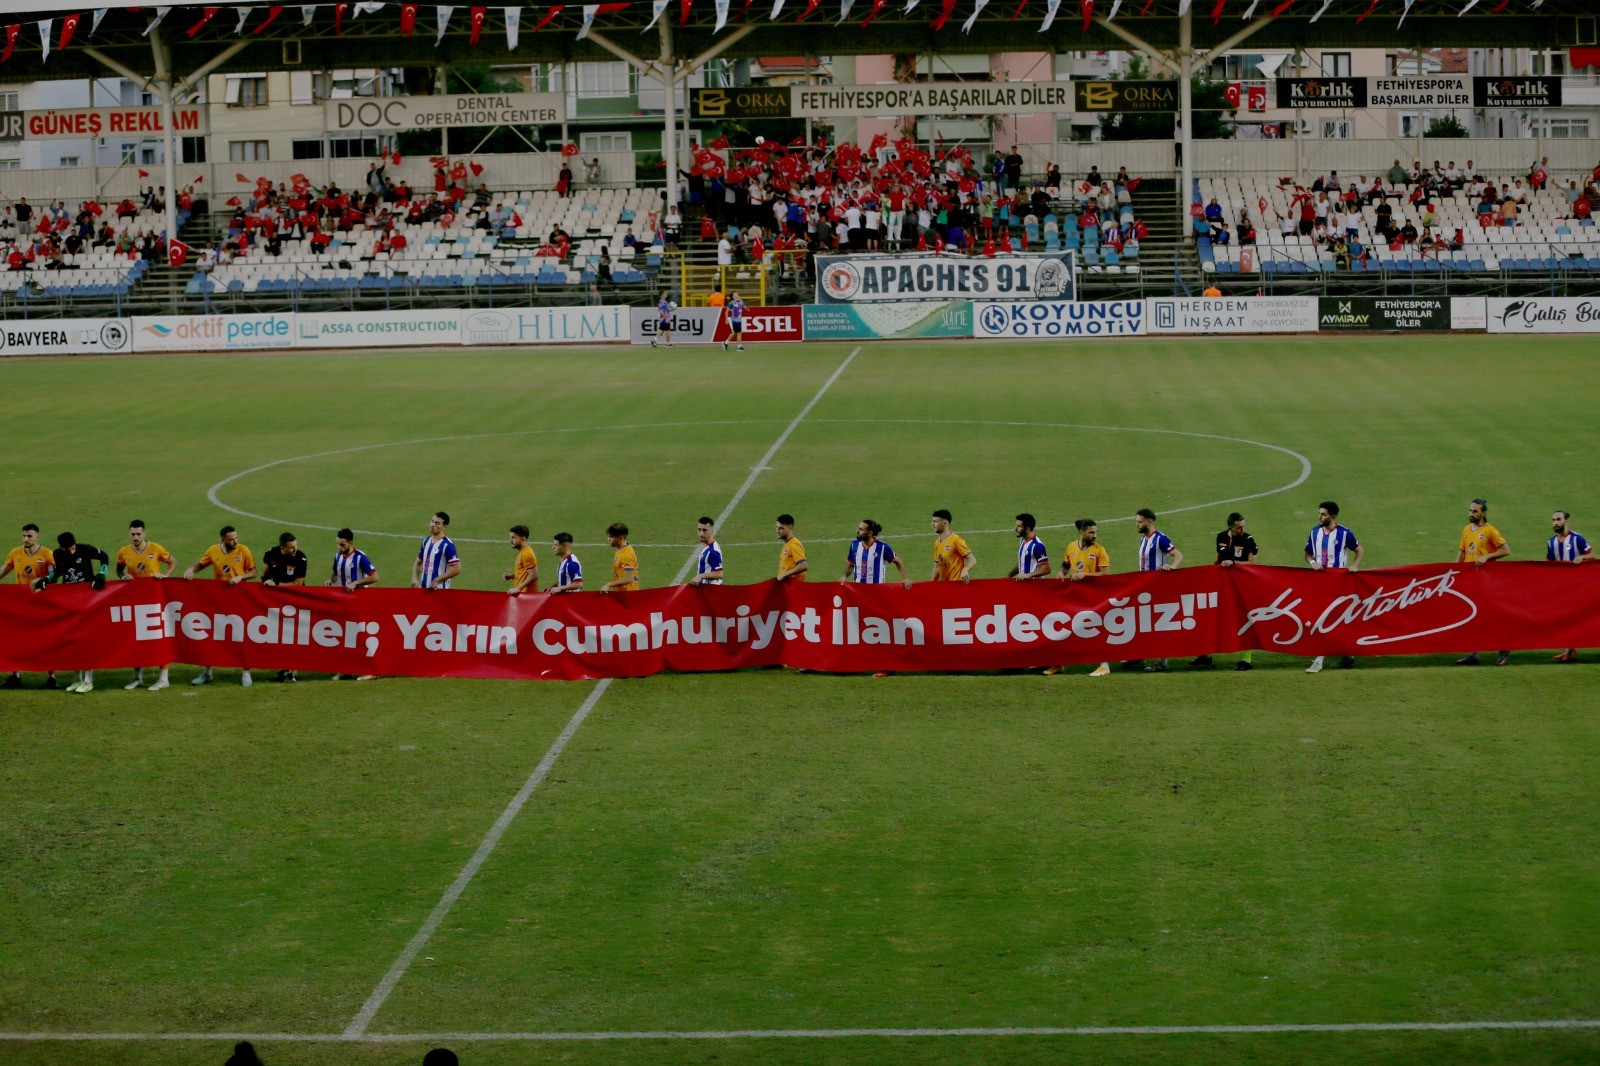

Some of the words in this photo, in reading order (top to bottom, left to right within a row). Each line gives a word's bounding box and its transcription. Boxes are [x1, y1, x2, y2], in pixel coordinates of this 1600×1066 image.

[1376, 78, 1463, 90] FETHİYESPOR'A
[736, 93, 787, 107] ORKA
[801, 86, 924, 110] FETHİYESPOR'A
[928, 88, 1016, 112] BAŞARILAR
[1021, 83, 1066, 106] DİLER
[1123, 87, 1174, 101] ORKA
[1371, 94, 1435, 107] BAŞARILAR
[1437, 92, 1469, 105] DİLER
[457, 97, 513, 110] DENTAL
[1290, 98, 1354, 109] Kuyumculuk
[1486, 97, 1549, 108] Kuyumculuk
[338, 101, 407, 128] DOC
[414, 111, 498, 126] OPERATION
[501, 109, 557, 122] CENTER
[29, 111, 102, 138] GÜNEŞ
[110, 110, 199, 132] REKLAM
[862, 264, 989, 294] APACHES
[996, 264, 1031, 293] 91
[1012, 301, 1142, 320] KOYUNCU
[1180, 301, 1248, 312] HERDEM
[1375, 300, 1441, 309] FETHİYESPOR'A
[1184, 315, 1245, 329] İNŞAAT
[1384, 310, 1432, 319] BAŞARILAR
[1523, 302, 1567, 328] Çalış
[176, 317, 224, 339] aktif
[227, 316, 289, 342] perde
[321, 322, 353, 334] ASSA
[357, 321, 457, 333] CONSTRUCTION
[517, 307, 621, 340] HİLMİ
[1012, 319, 1142, 335] OTOMOTİV
[1395, 318, 1421, 327] DİLER
[7, 331, 68, 346] BAVYERA
[110, 601, 380, 657] "Efendiler;
[392, 614, 518, 654] Yarın
[532, 604, 821, 656] Cumhuriyet
[832, 595, 925, 646] İlan
[942, 592, 1218, 646] Edeceğiz!"
